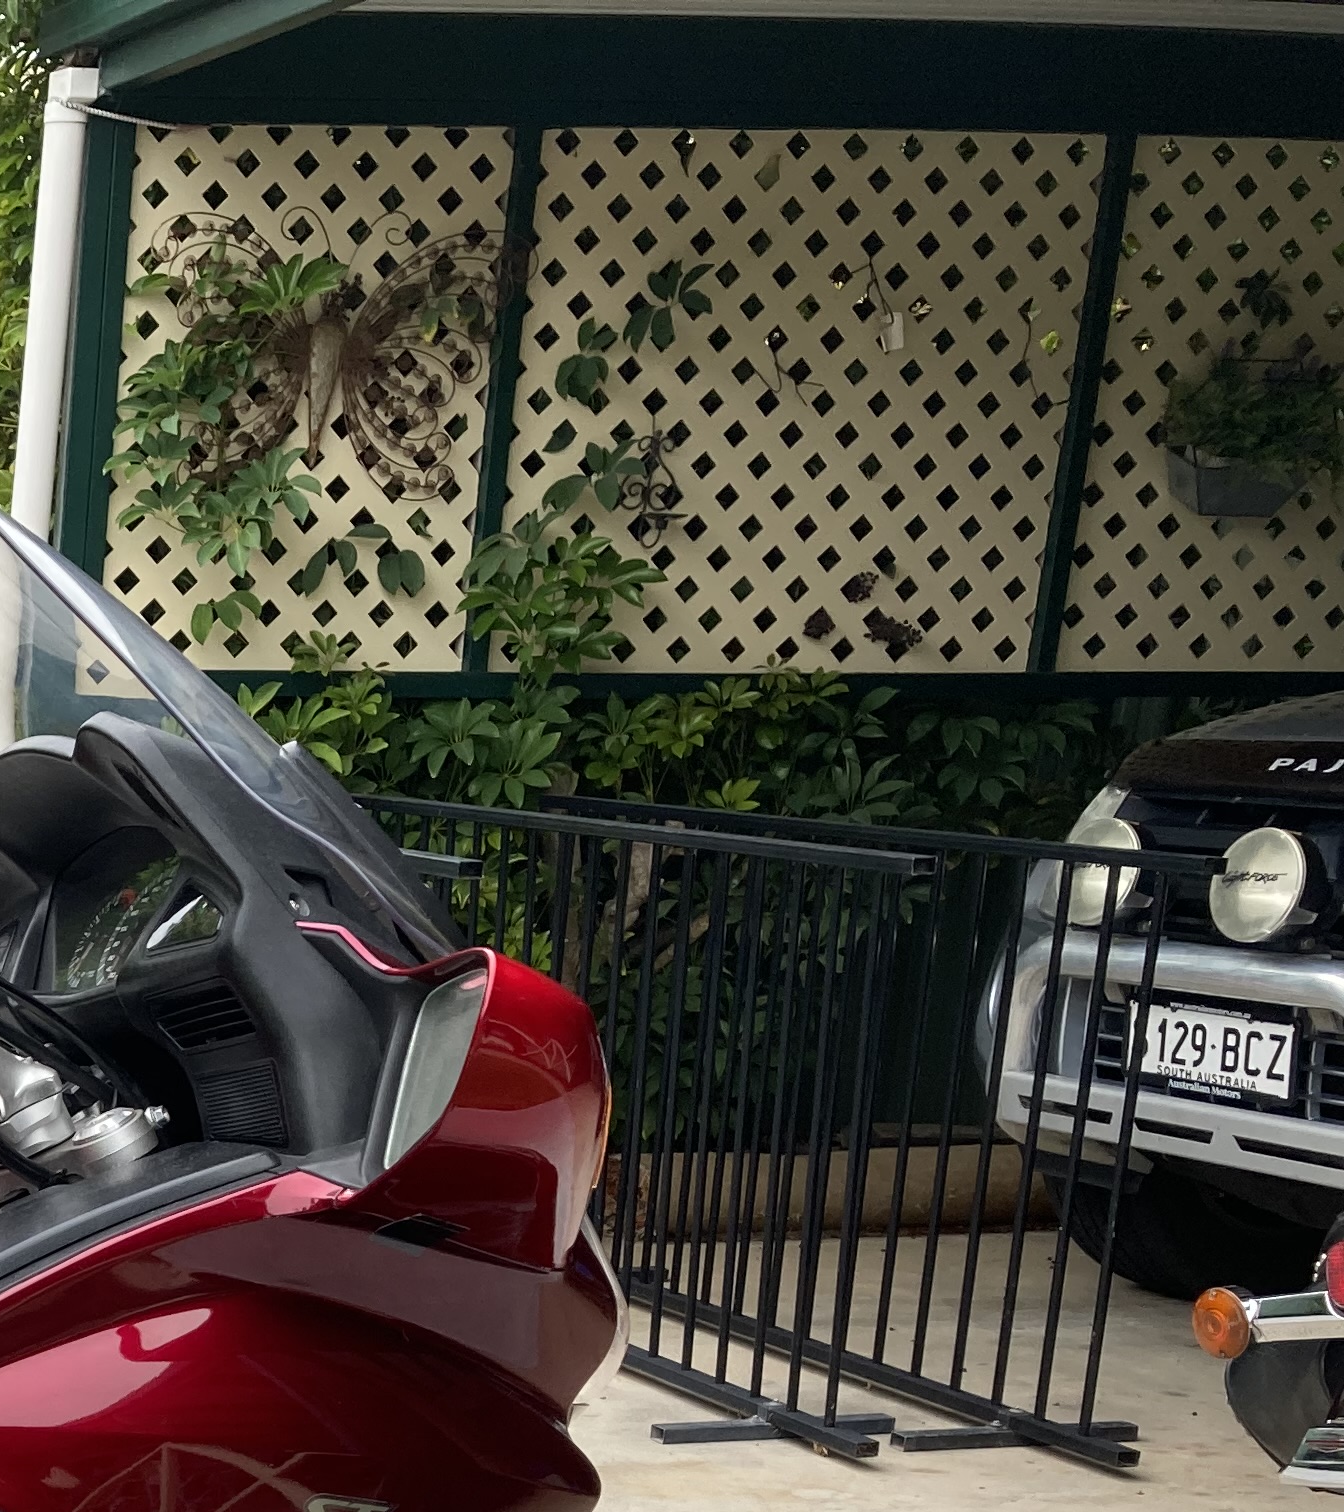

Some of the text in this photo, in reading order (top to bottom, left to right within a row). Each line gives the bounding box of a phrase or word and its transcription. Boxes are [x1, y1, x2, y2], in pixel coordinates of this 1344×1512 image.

[1140, 1017, 1288, 1082] 129·BCZ
[1156, 1064, 1257, 1091] SOUTH AUSTRALIA
